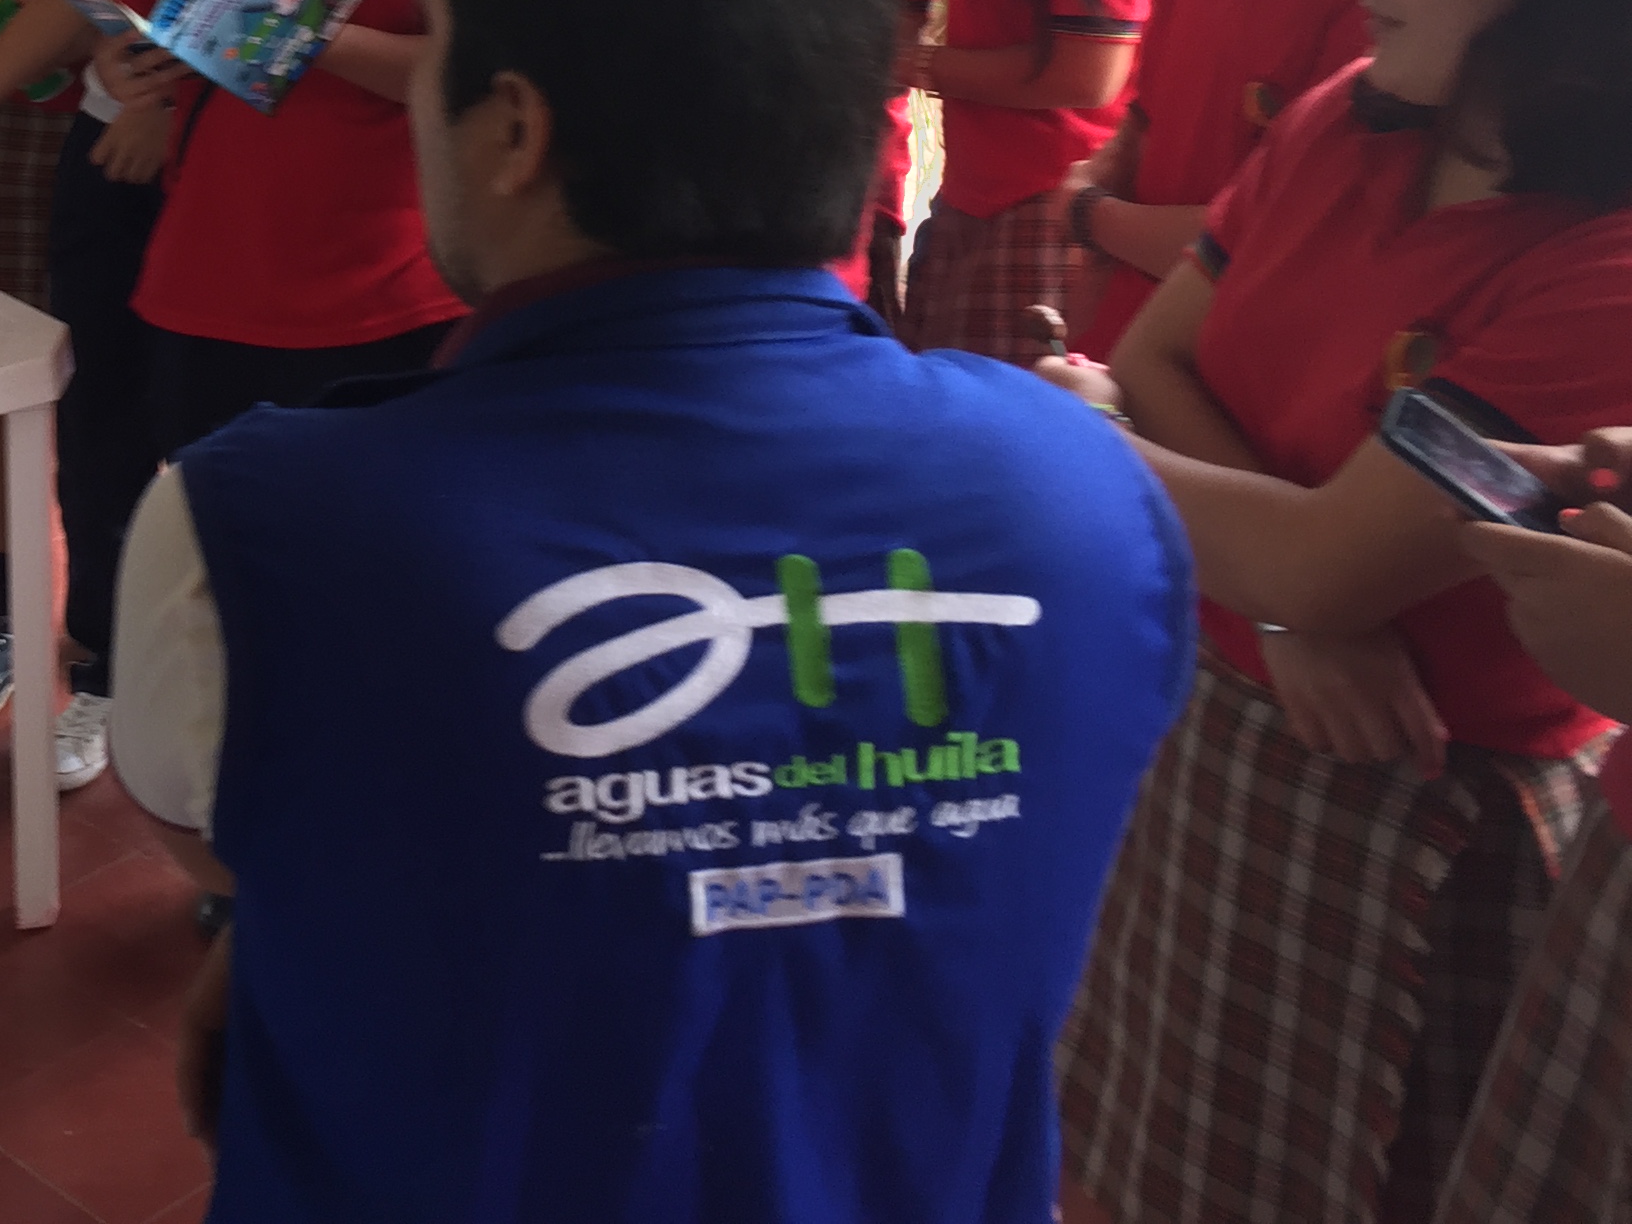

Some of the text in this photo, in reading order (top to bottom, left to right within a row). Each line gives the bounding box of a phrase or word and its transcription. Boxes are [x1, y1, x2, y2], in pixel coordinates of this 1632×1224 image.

[542, 731, 1021, 824] aguas del huila
